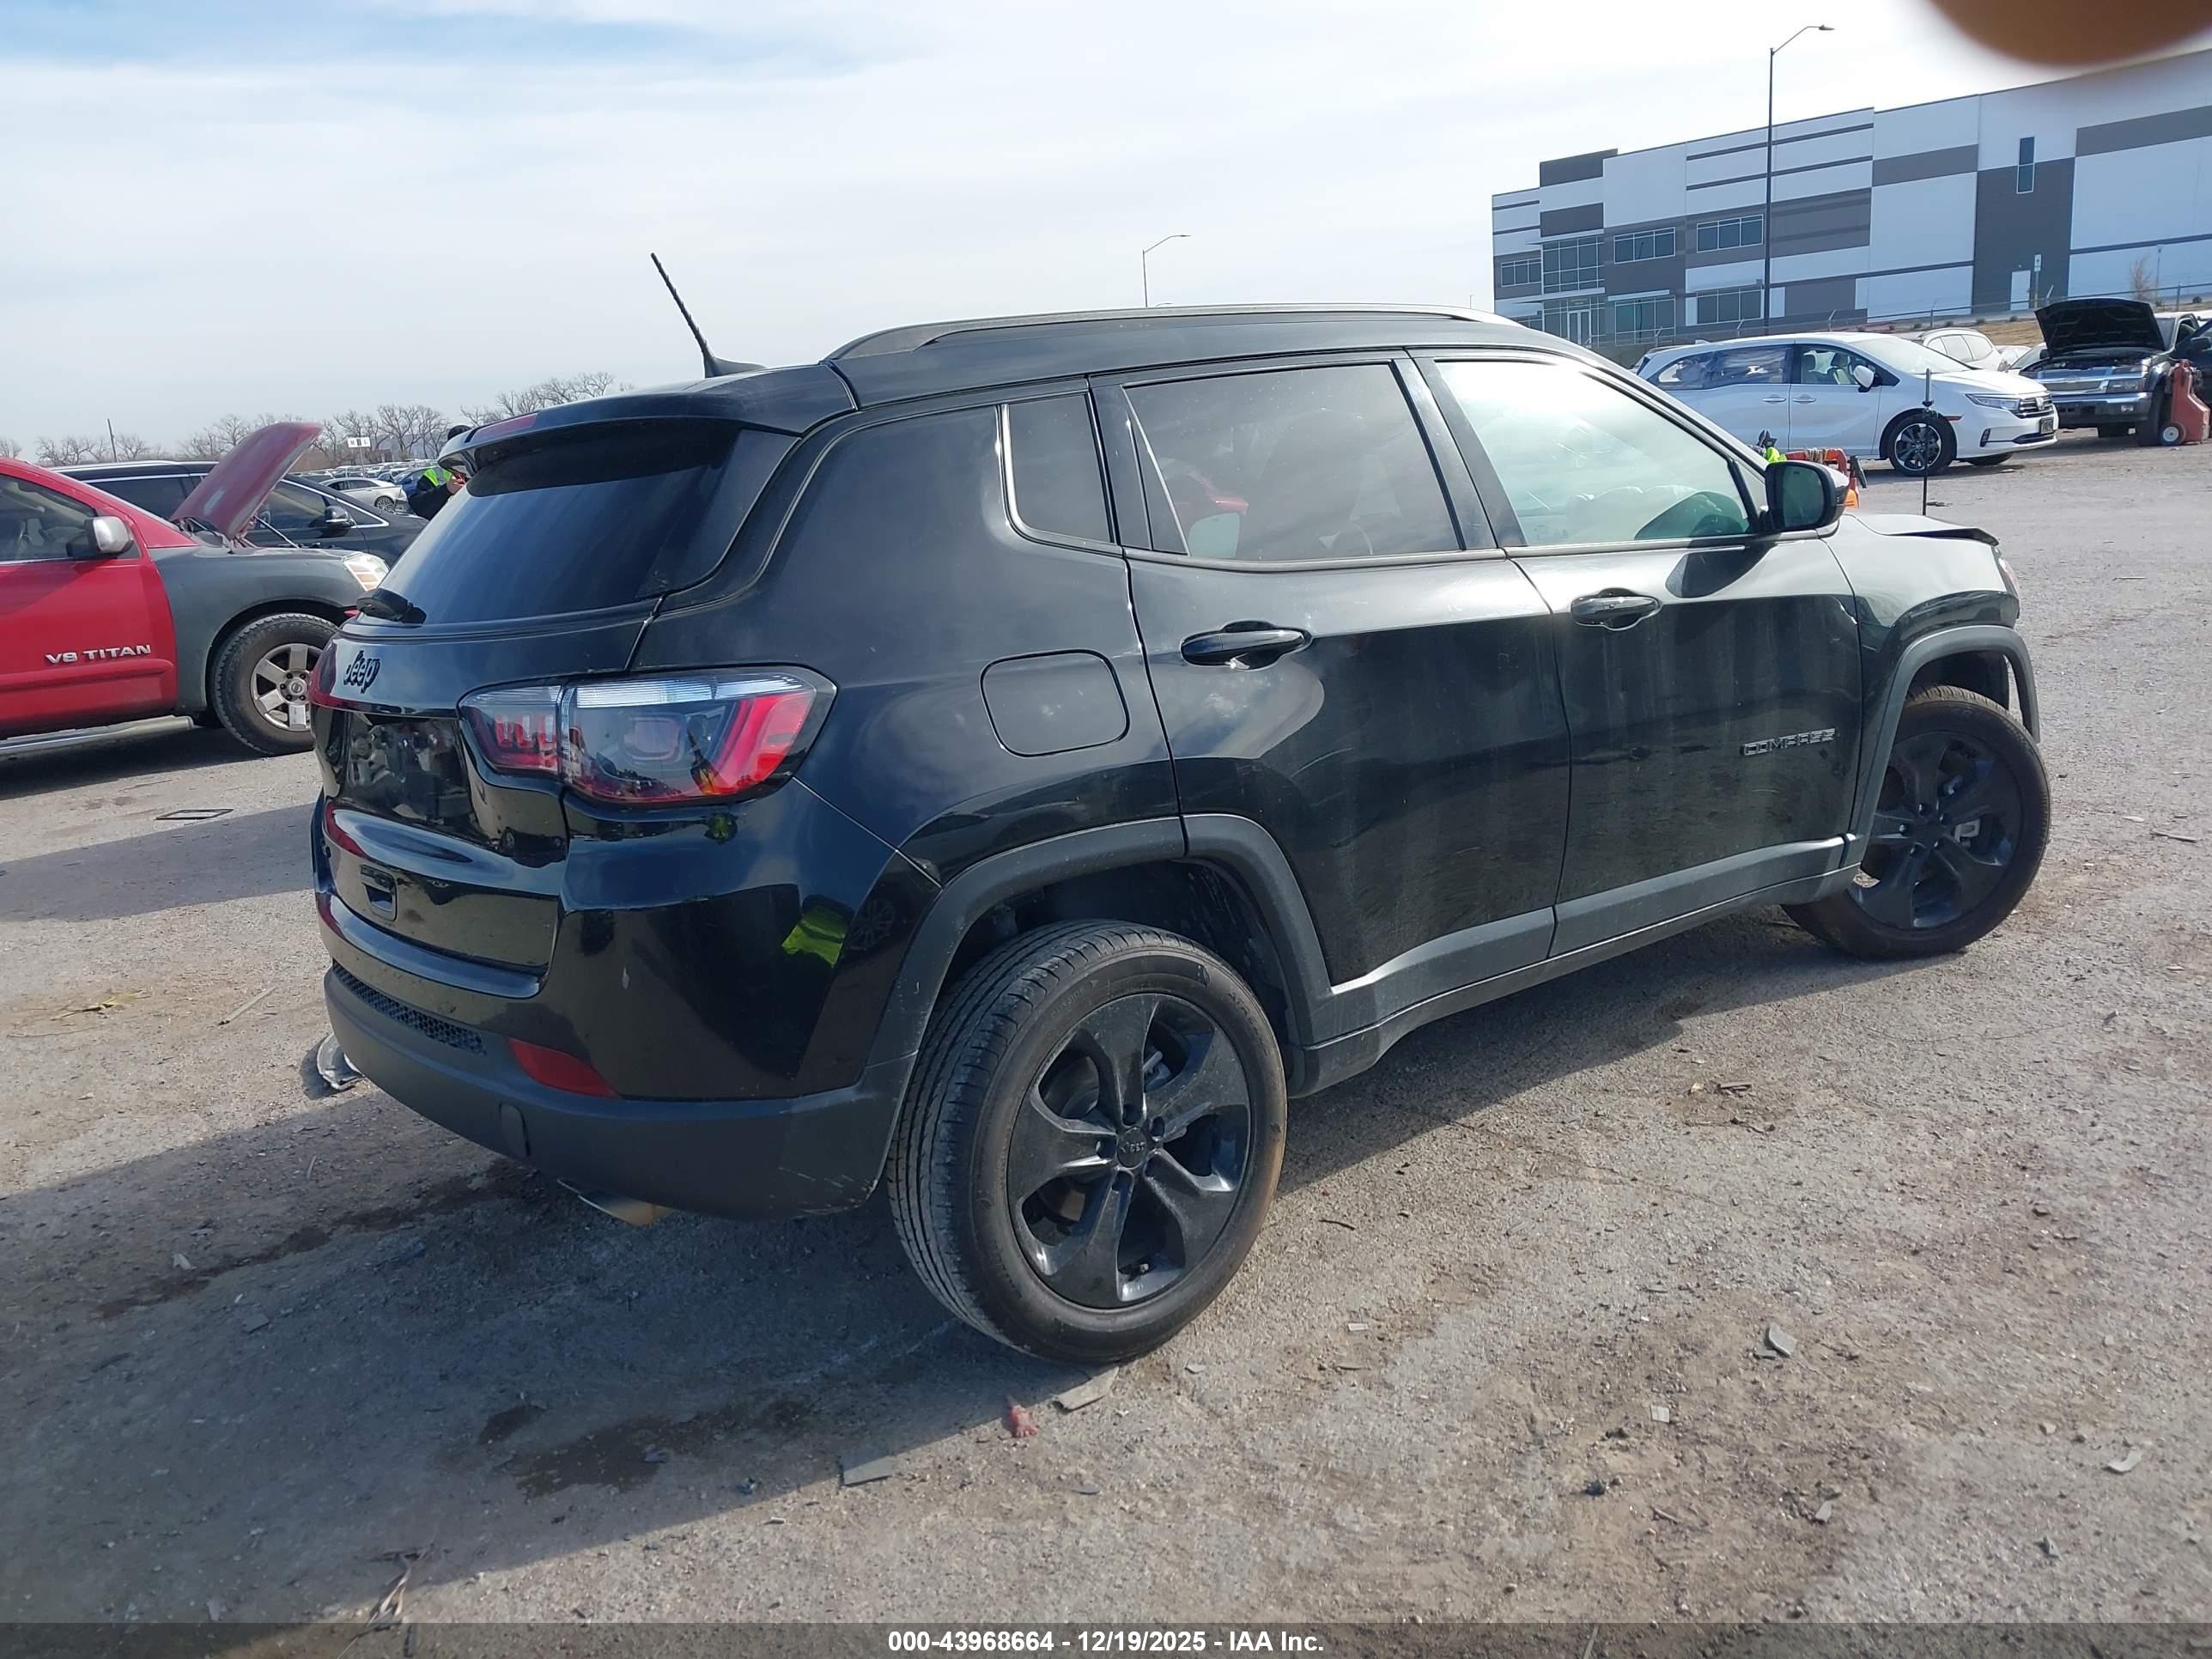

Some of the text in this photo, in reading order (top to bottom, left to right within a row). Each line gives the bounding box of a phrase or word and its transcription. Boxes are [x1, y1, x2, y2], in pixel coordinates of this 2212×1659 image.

[44, 643, 152, 665] V8 TITAN
[343, 649, 381, 694] Jeep
[1743, 728, 1836, 757] COMPASS
